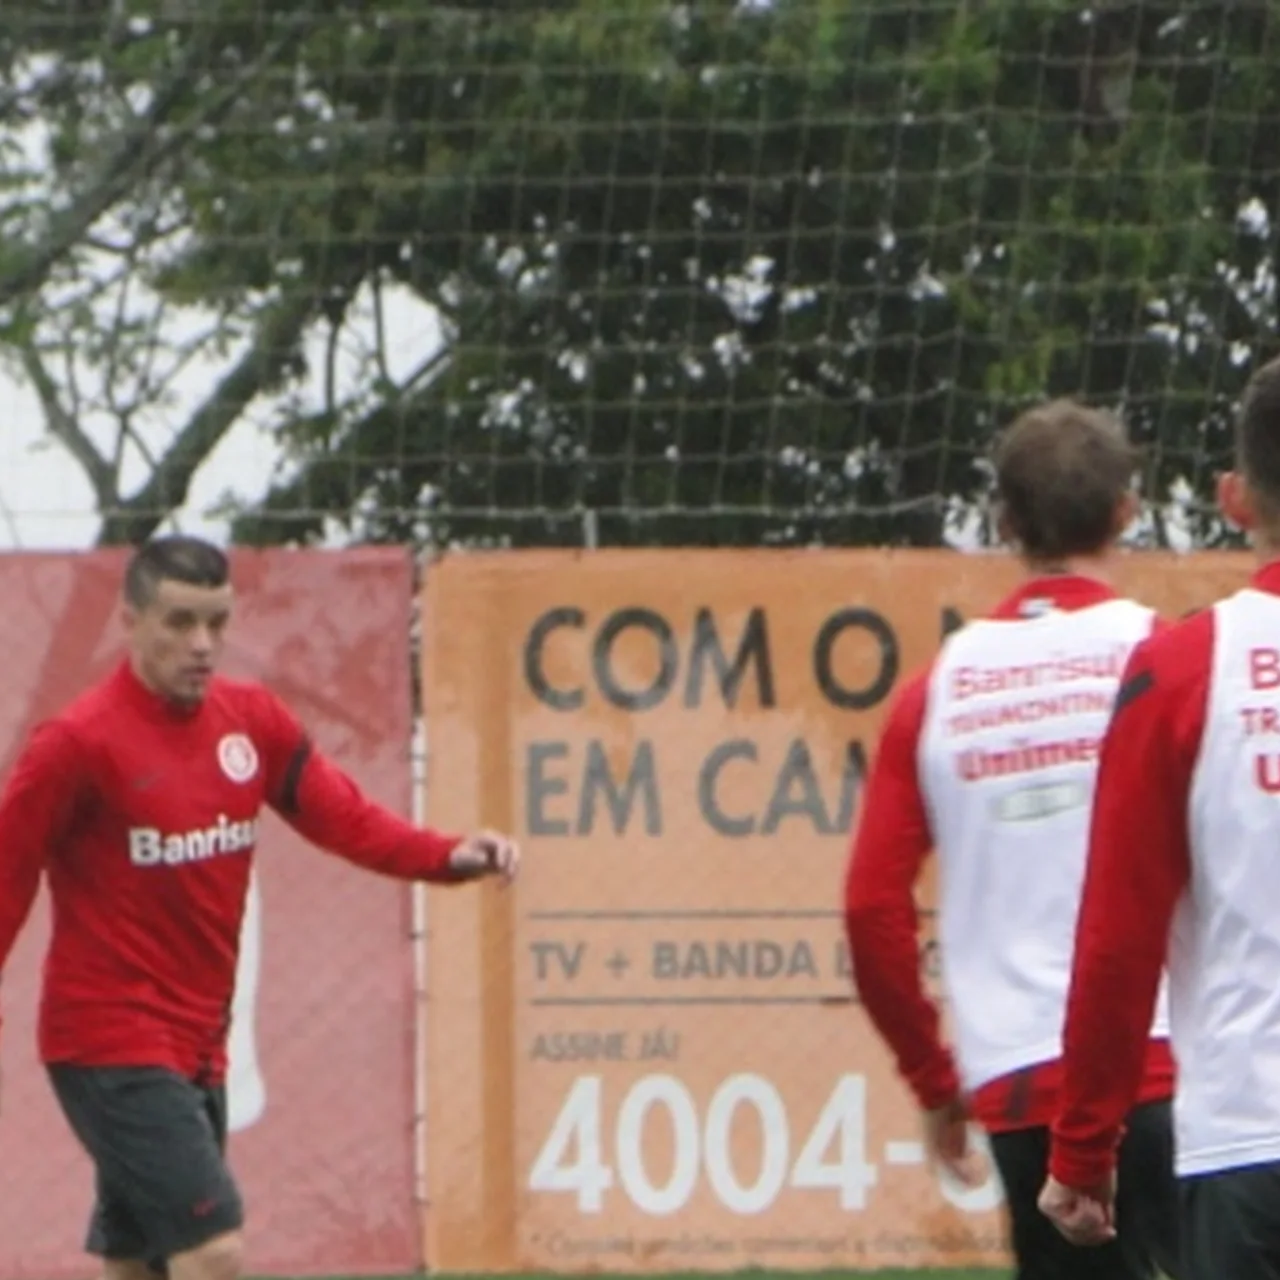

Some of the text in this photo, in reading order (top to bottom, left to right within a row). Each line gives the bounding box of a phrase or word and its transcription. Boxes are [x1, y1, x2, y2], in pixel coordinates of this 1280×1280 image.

[523, 605, 775, 711] COM
[812, 606, 901, 710] O
[526, 740, 664, 837] EM
[956, 737, 1100, 782] Unime
[530, 941, 586, 981] TV
[650, 941, 820, 981] BANDA
